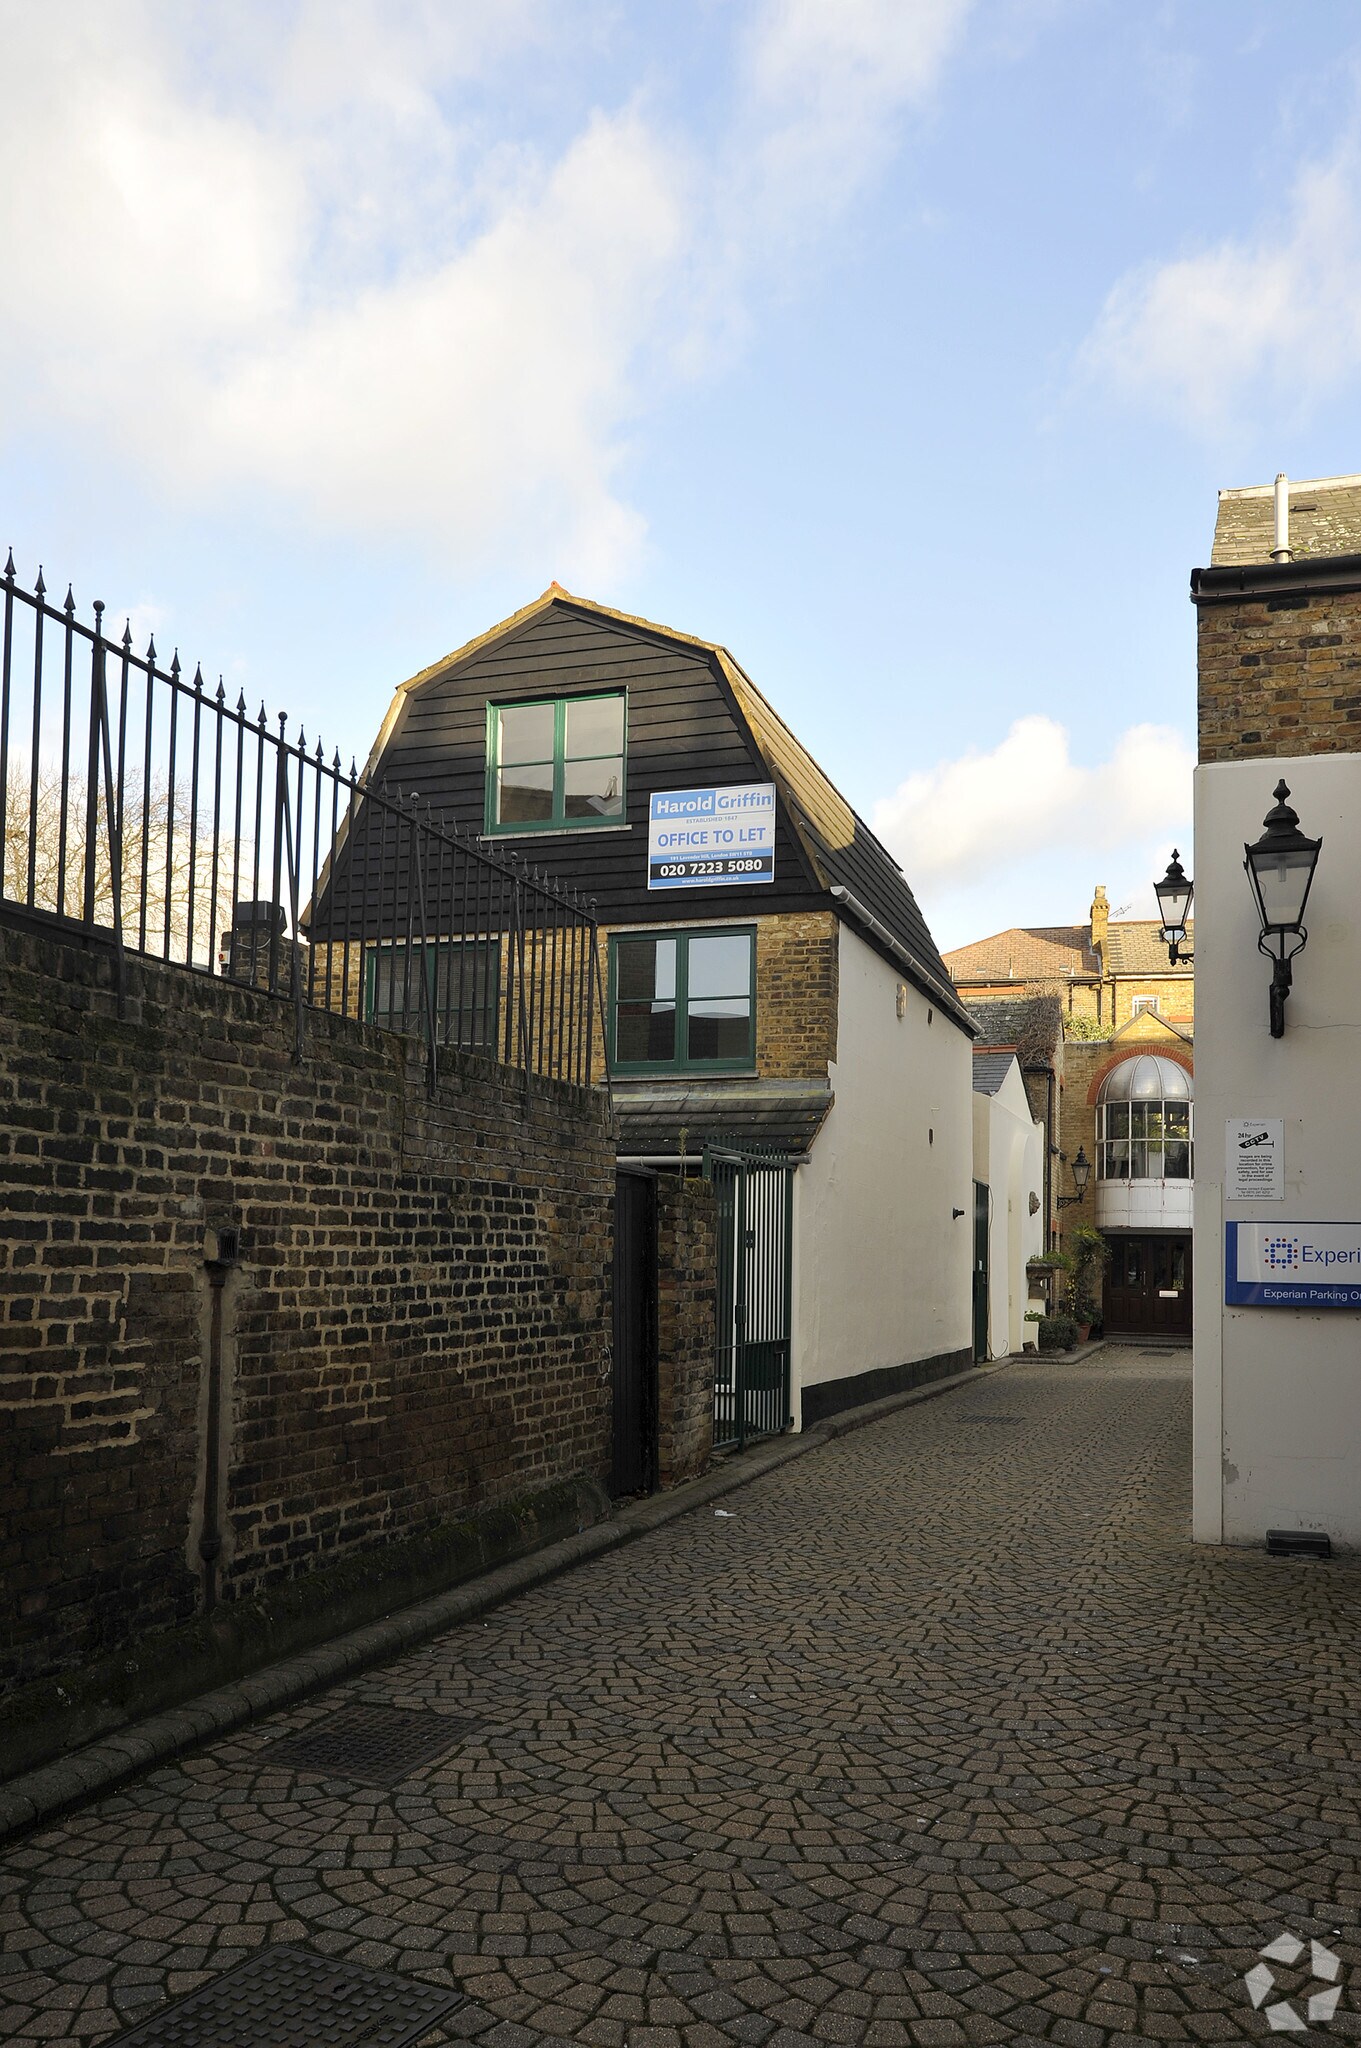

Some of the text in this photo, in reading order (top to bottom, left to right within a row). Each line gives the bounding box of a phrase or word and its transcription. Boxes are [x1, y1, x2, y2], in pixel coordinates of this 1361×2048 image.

[656, 793, 772, 814] Harold Griffin
[686, 816, 723, 824] ESTABLISHED
[657, 827, 766, 847] OFFICE TO LET
[660, 859, 763, 877] 020 7223 5080
[1244, 1134, 1264, 1147] CCTV
[1302, 1245, 1361, 1267] Experi
[1263, 1289, 1361, 1302] Experian Parking O
